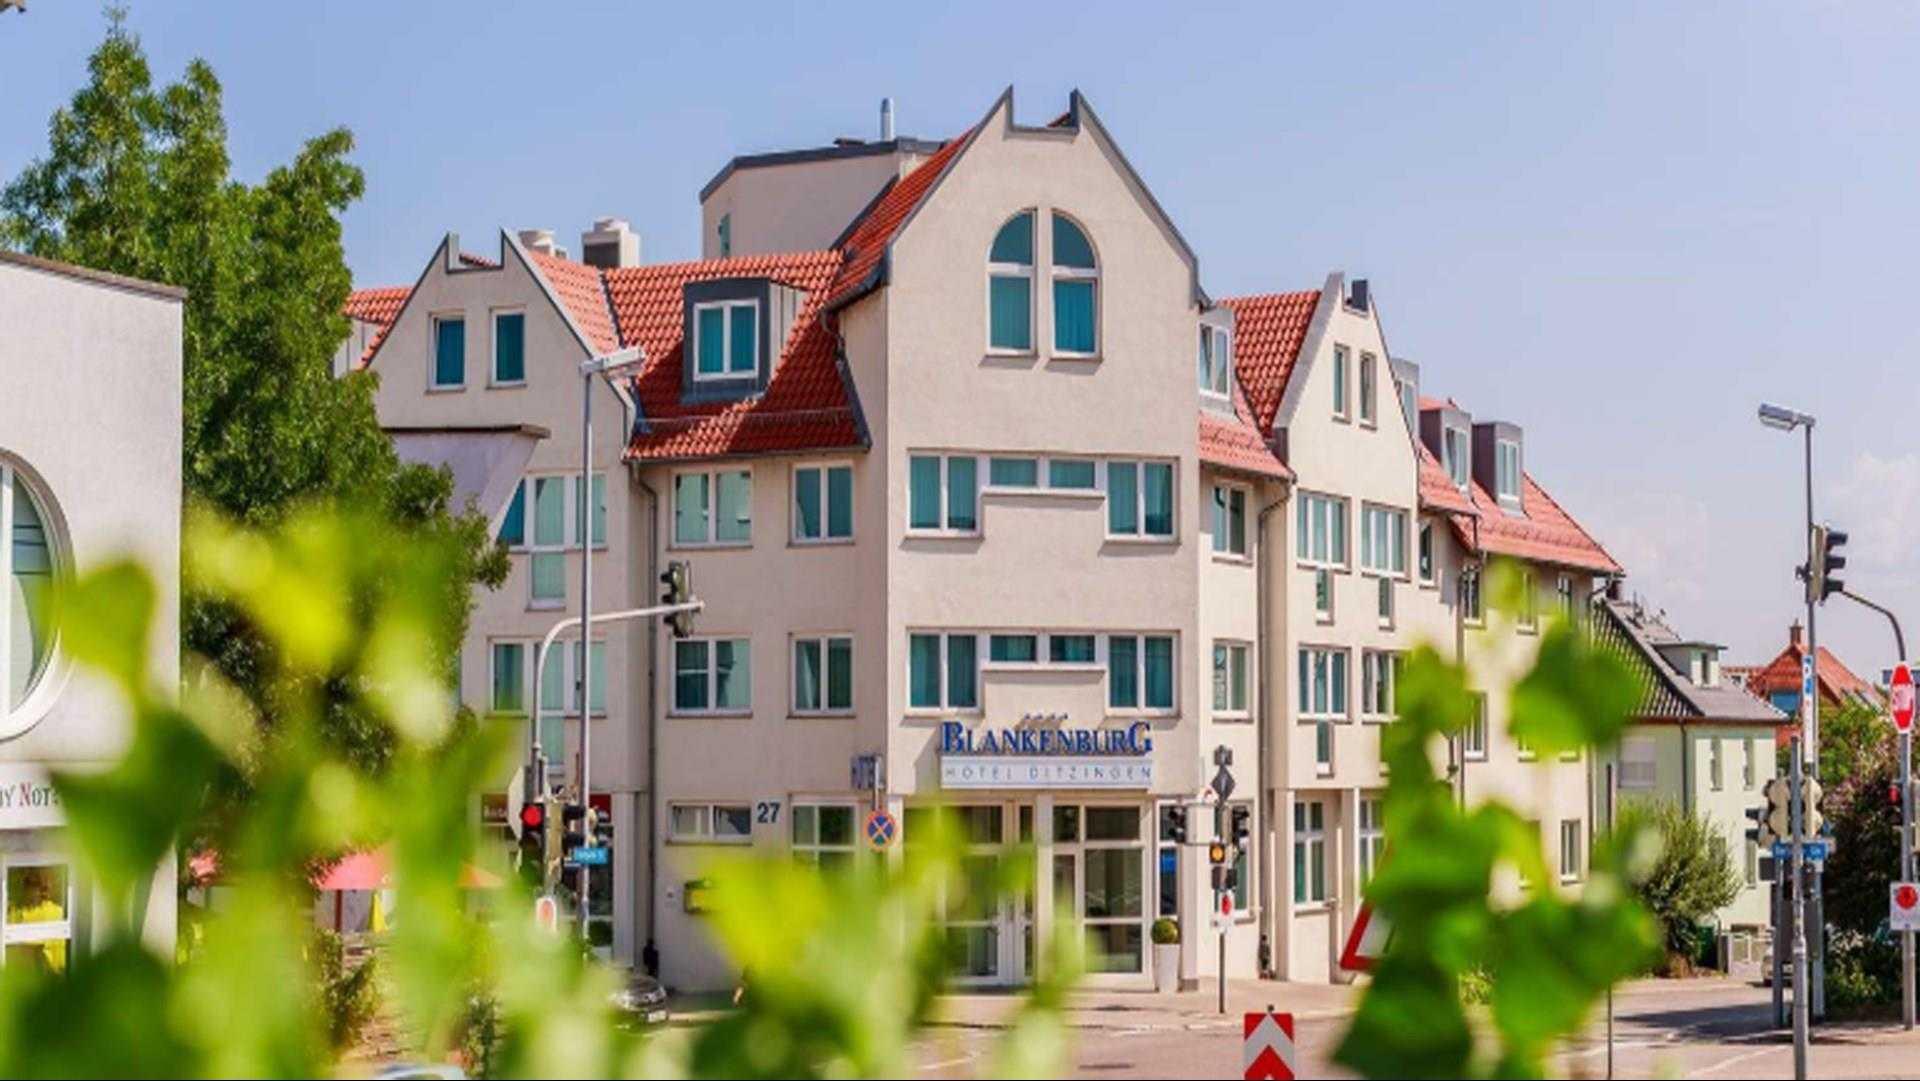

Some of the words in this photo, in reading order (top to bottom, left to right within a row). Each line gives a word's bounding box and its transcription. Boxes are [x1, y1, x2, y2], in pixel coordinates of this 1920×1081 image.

[943, 720, 1153, 753] BLANKENBURG
[945, 765, 1012, 780] HOTEL
[1028, 765, 1151, 780] DITZINGEN
[756, 801, 781, 824] 27
